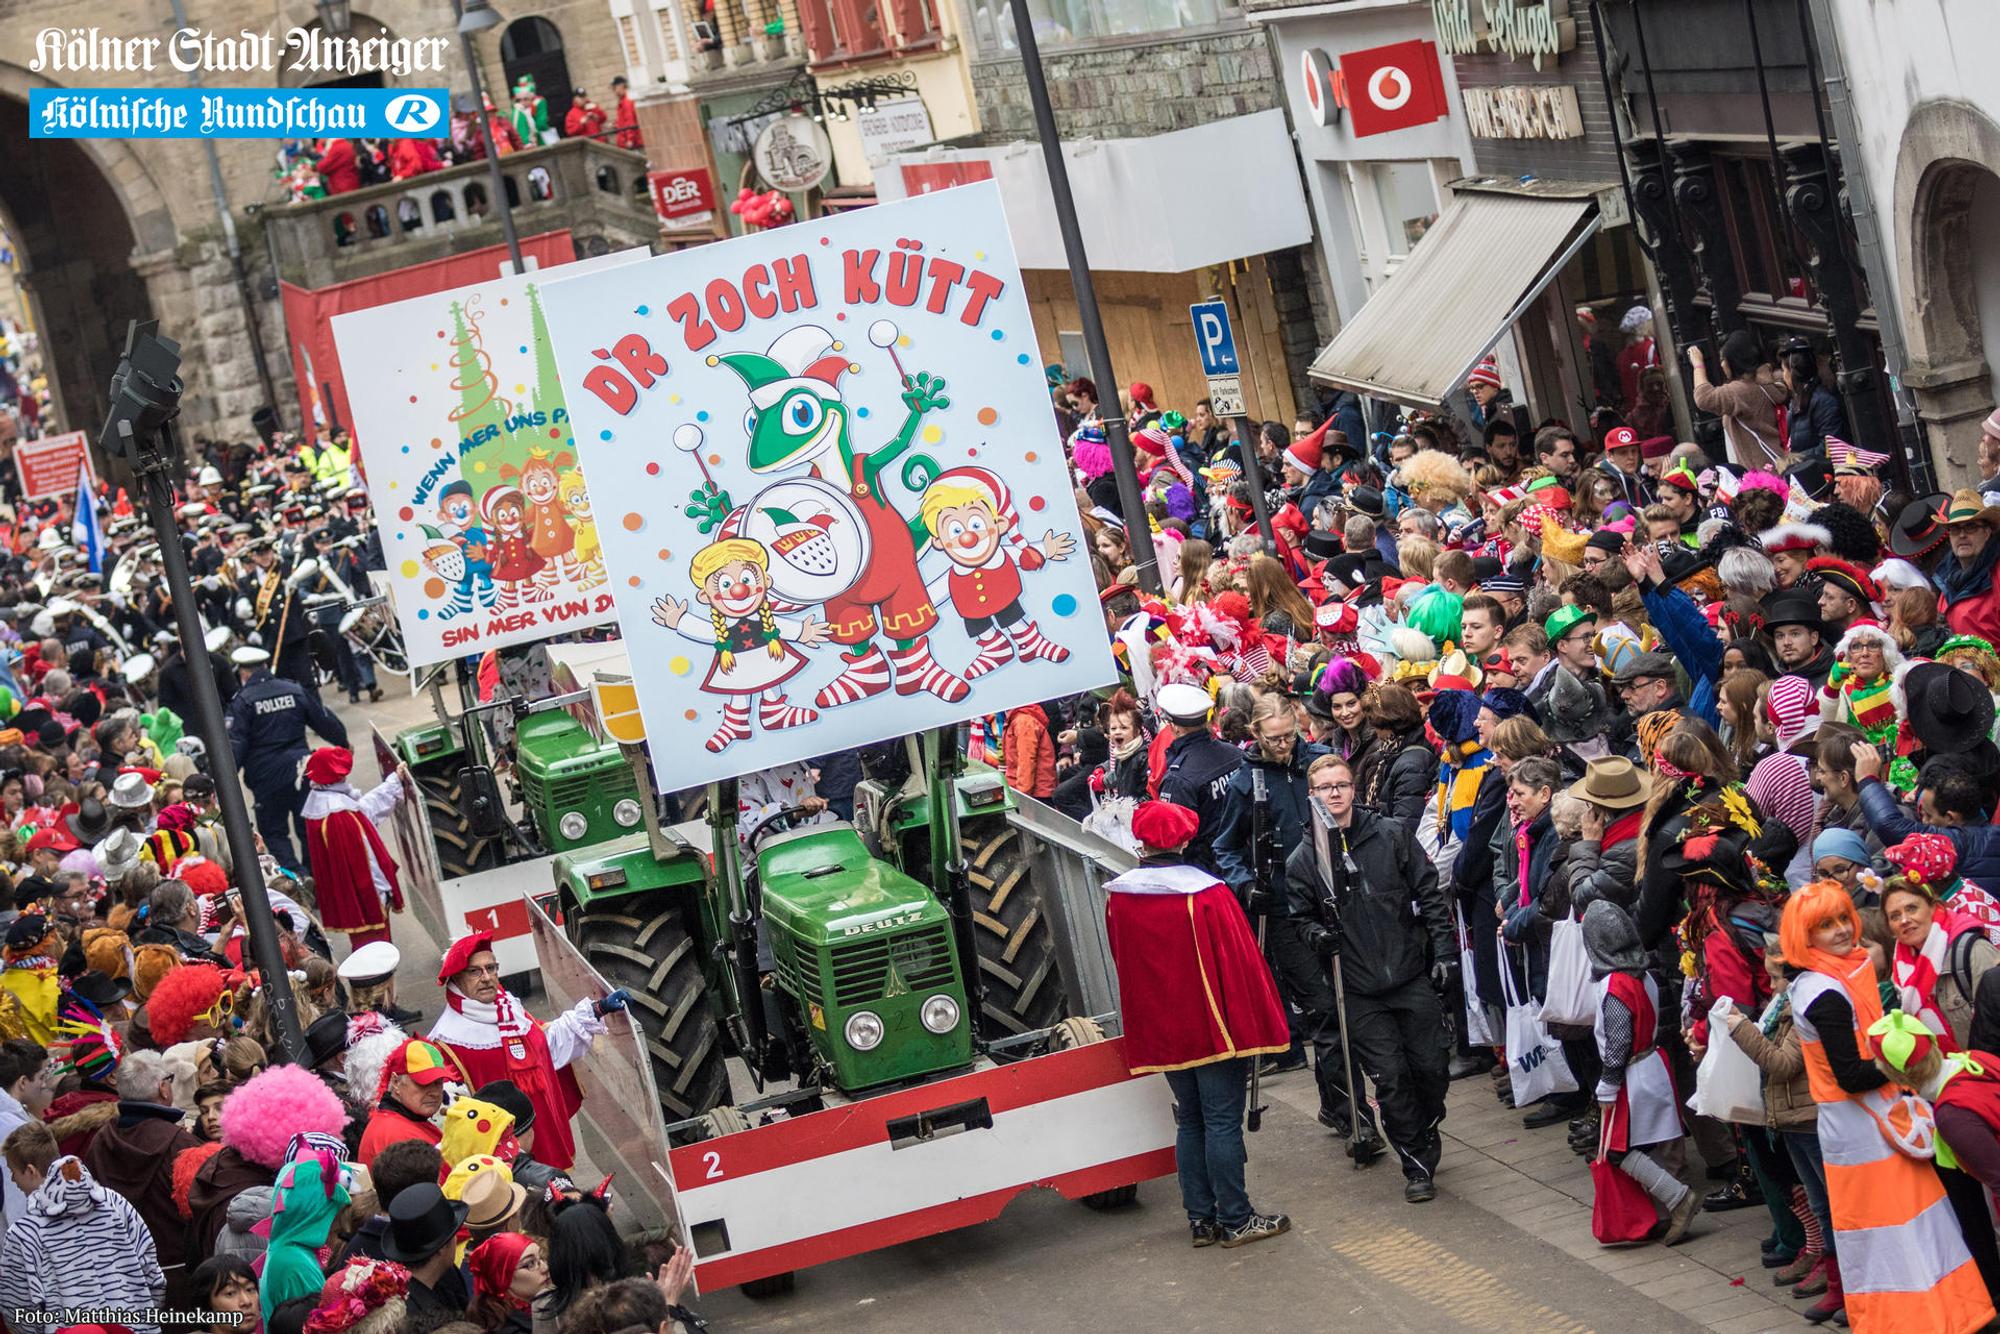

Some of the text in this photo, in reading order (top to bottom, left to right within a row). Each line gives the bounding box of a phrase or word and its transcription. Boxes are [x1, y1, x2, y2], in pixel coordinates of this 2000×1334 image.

[662, 177, 702, 205] DER
[666, 253, 819, 352] ZOCH
[842, 237, 1005, 327] KÜTT
[1200, 312, 1223, 366] P
[412, 452, 456, 505] WENN
[458, 423, 500, 456] MER
[504, 411, 547, 434] UNS
[1709, 507, 1729, 519] FBI
[441, 618, 480, 648] SIN
[486, 611, 538, 637] MER
[542, 600, 589, 623] VUN
[254, 694, 297, 715] POLIZEI
[487, 908, 499, 929] 1
[843, 911, 924, 936] DEUTZ
[702, 1151, 724, 1179] 2
